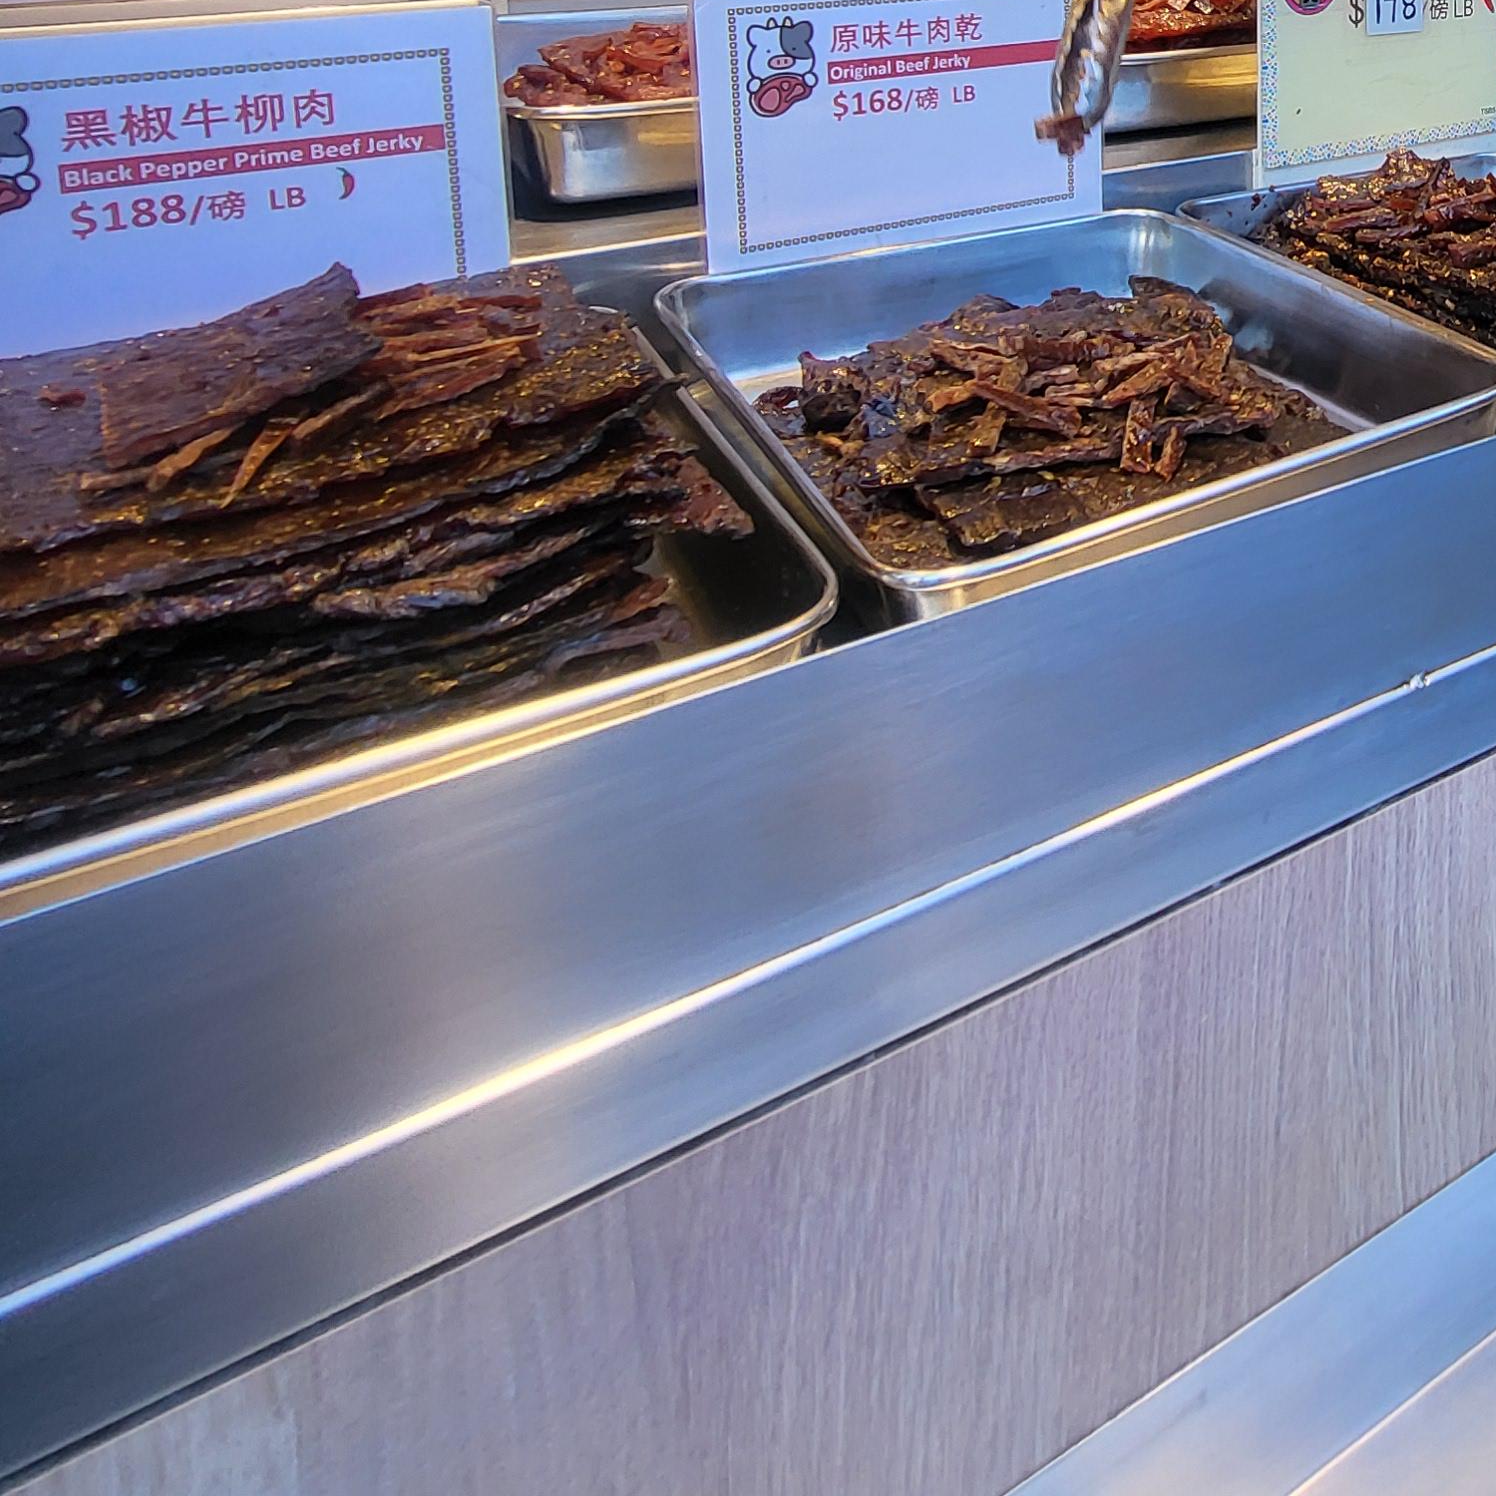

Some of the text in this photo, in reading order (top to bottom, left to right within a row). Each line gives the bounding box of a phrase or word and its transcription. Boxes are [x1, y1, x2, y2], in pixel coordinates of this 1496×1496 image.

[830, 13, 983, 53] 原味牛肉乾
[830, 53, 971, 81] Original Beef Jerky
[61, 88, 335, 153] 黑椒牛柳肉
[833, 85, 976, 122] $168/磅 LB
[63, 131, 424, 188] Black Pepper Prime Beef Jerky
[70, 187, 306, 241] $188/磅 LB
